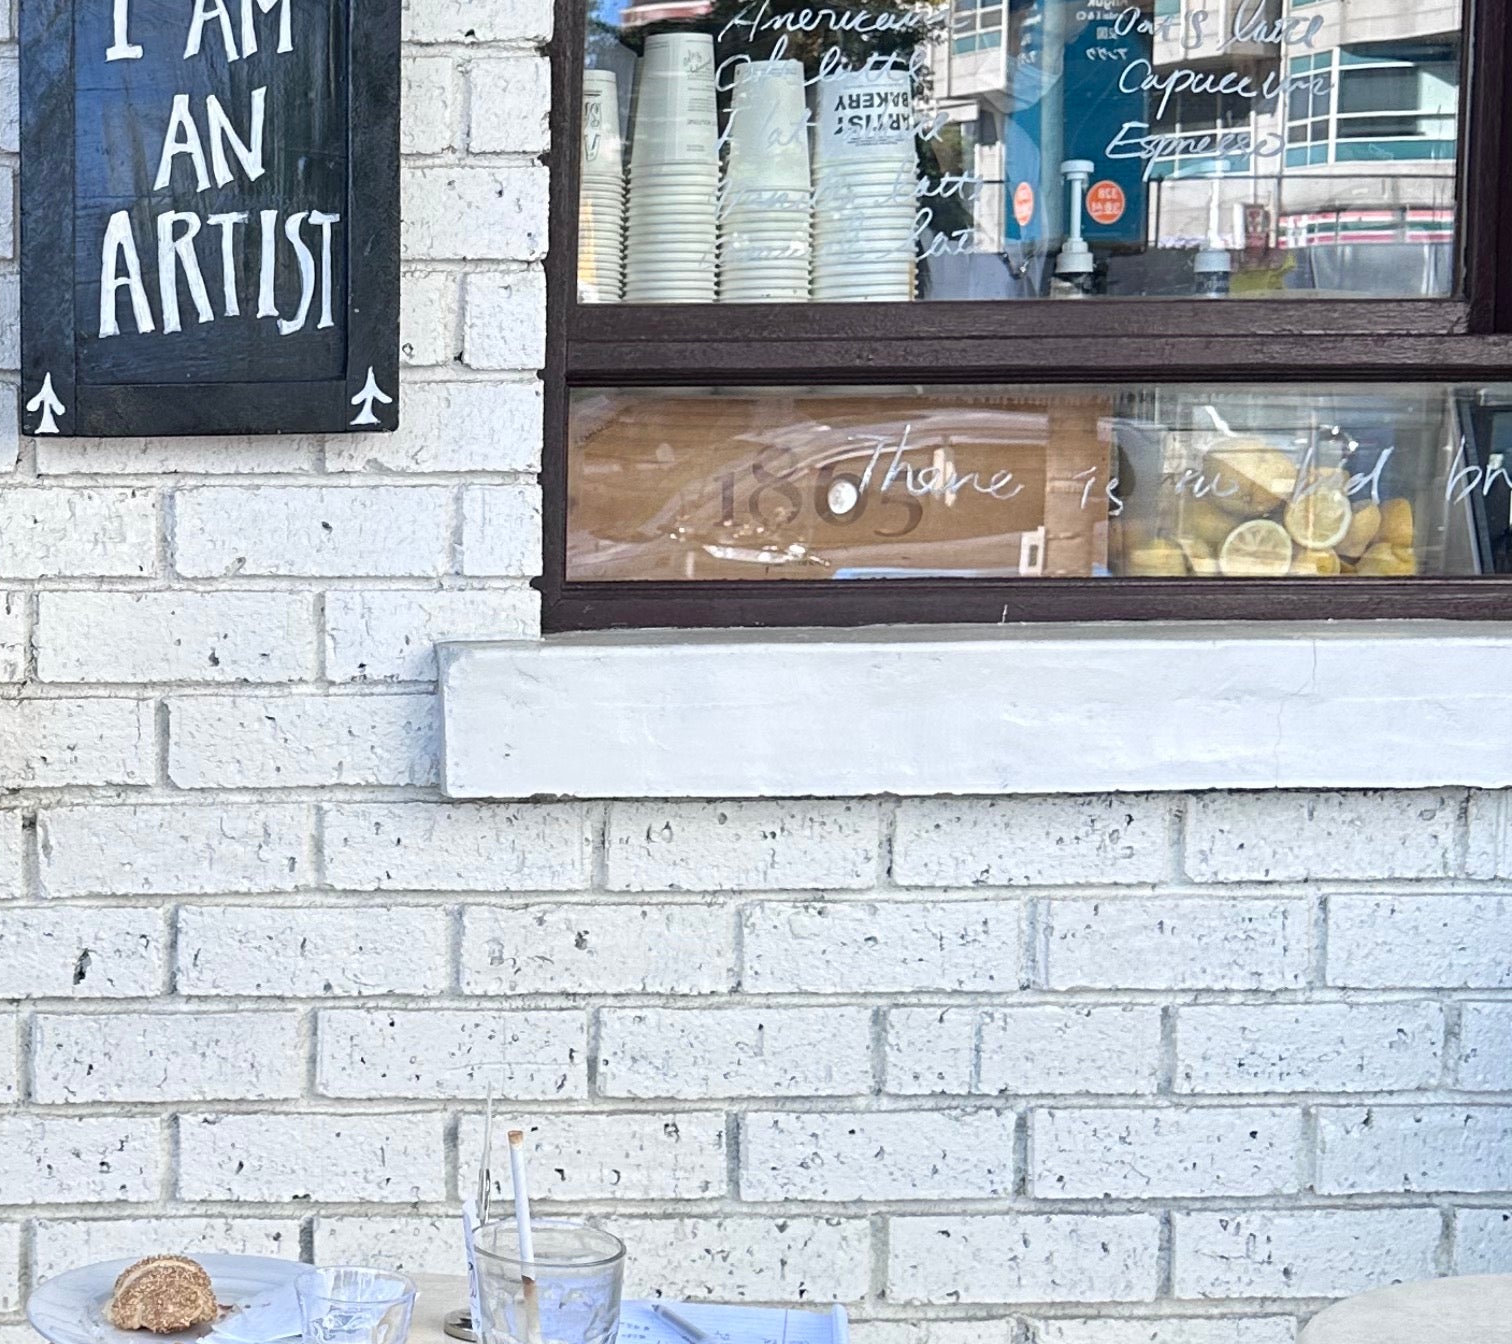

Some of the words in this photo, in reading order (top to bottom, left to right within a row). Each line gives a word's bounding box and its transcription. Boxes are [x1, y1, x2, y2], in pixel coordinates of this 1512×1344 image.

[154, 86, 267, 191] AN
[834, 90, 910, 112] BAKERY
[98, 210, 340, 338] ARTIST
